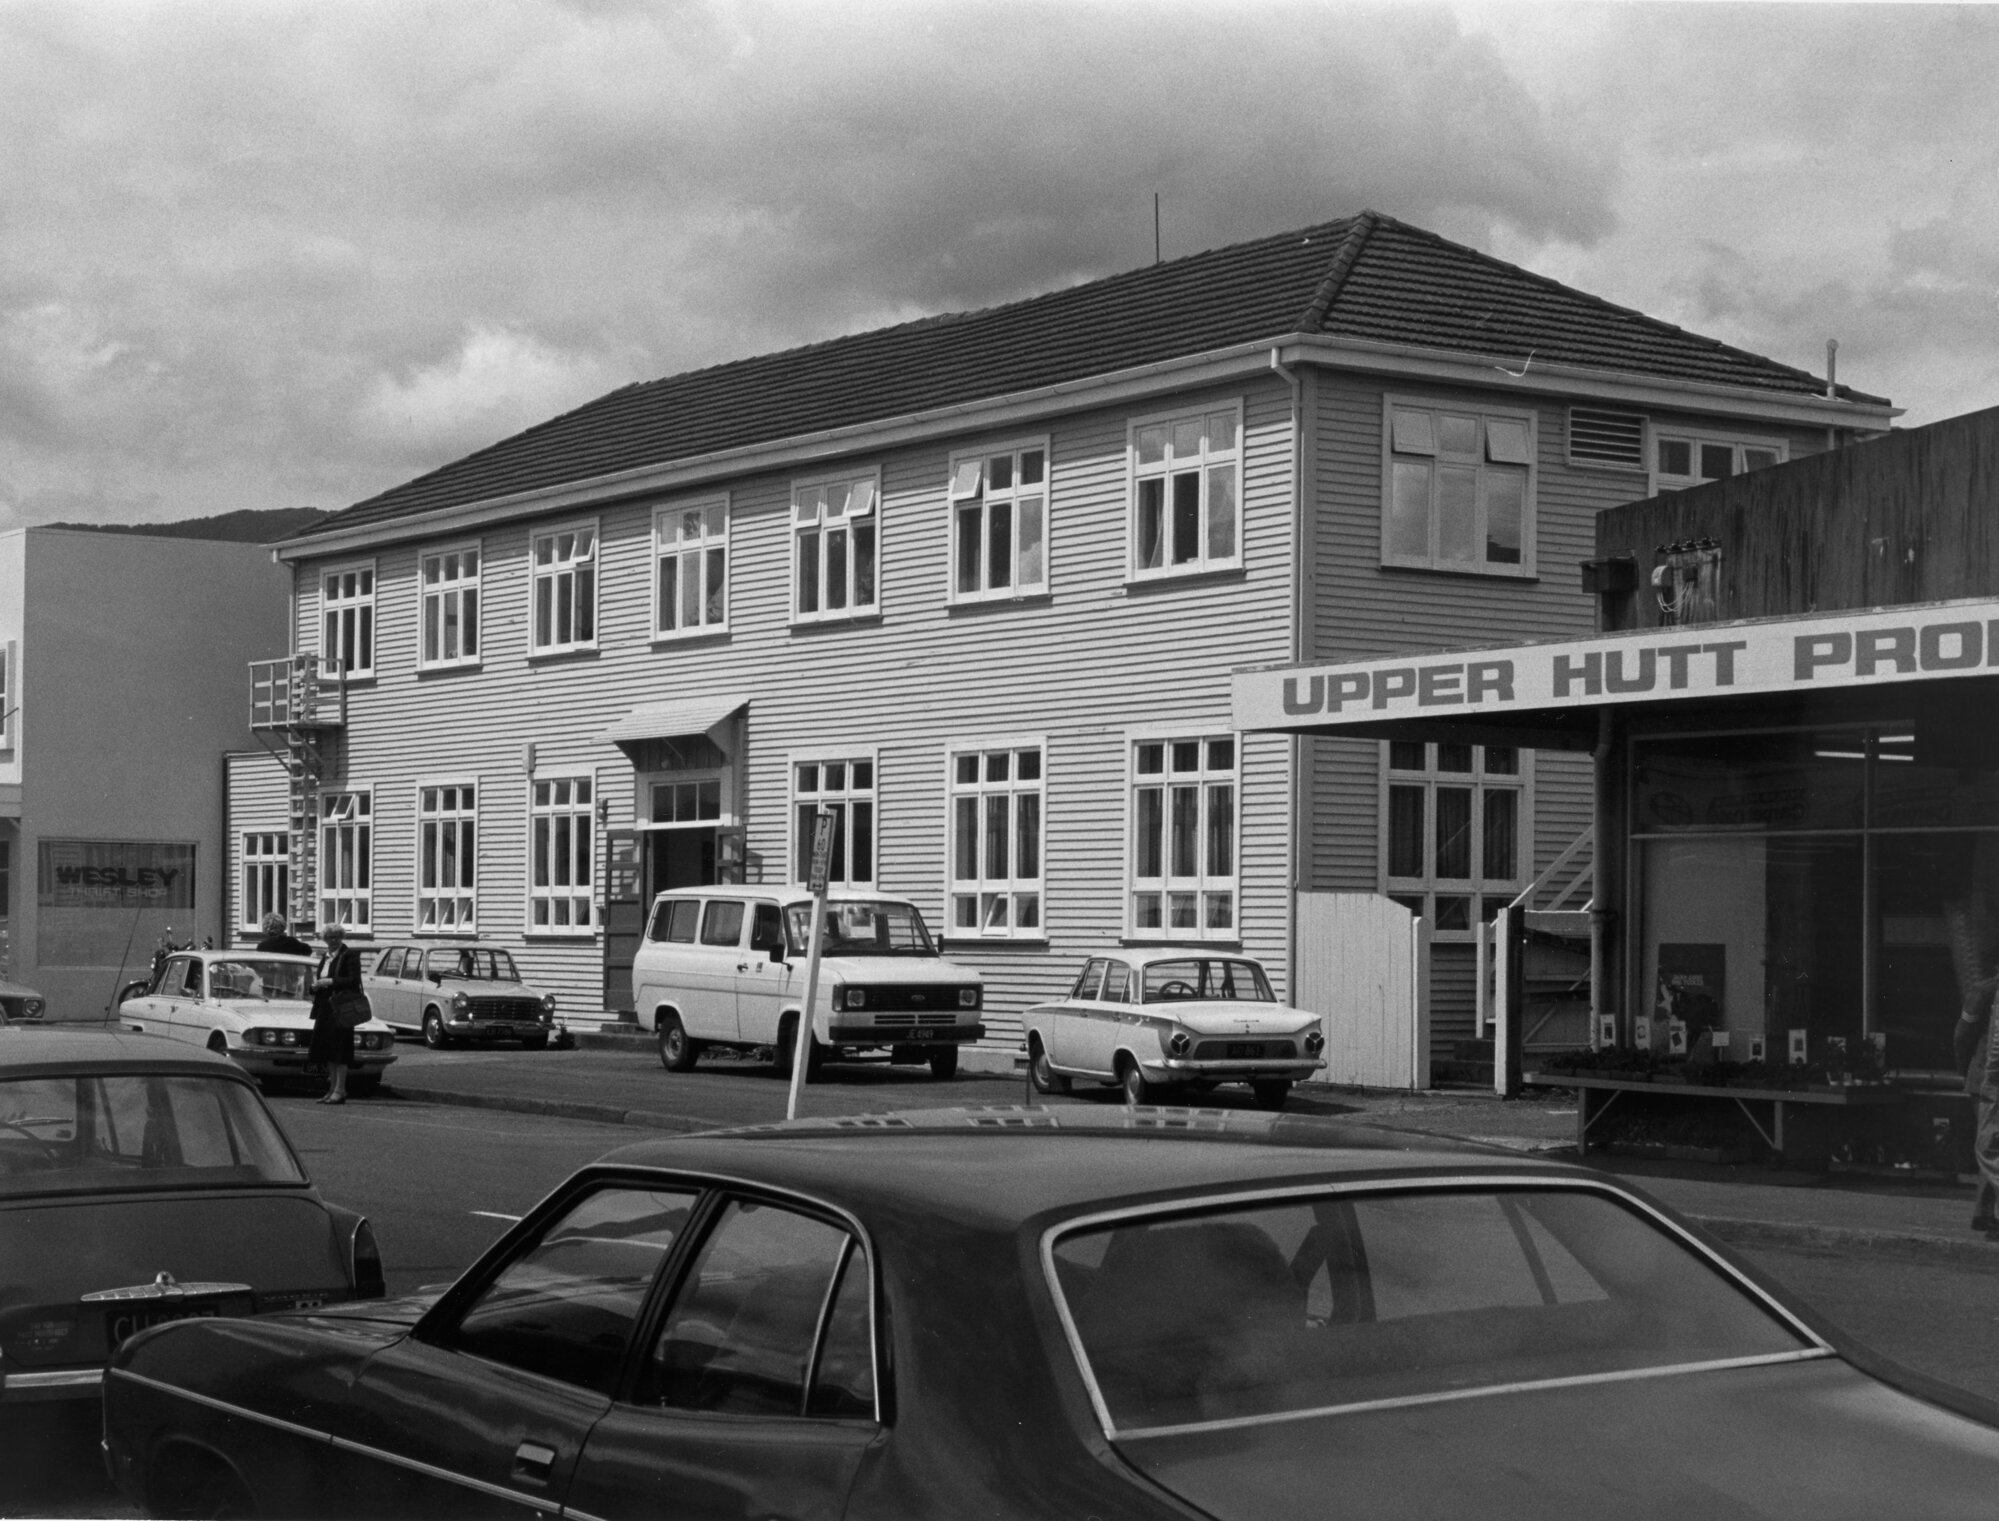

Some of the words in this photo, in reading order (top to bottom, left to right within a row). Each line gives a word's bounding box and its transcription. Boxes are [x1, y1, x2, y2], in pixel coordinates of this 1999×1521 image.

[1283, 659, 1515, 716] UPPER
[1553, 640, 1747, 698] HUTT
[1794, 618, 1999, 681] PRO
[56, 866, 180, 886] WESLEY
[70, 887, 121, 898] THRIFT
[127, 887, 168, 898] SHOP
